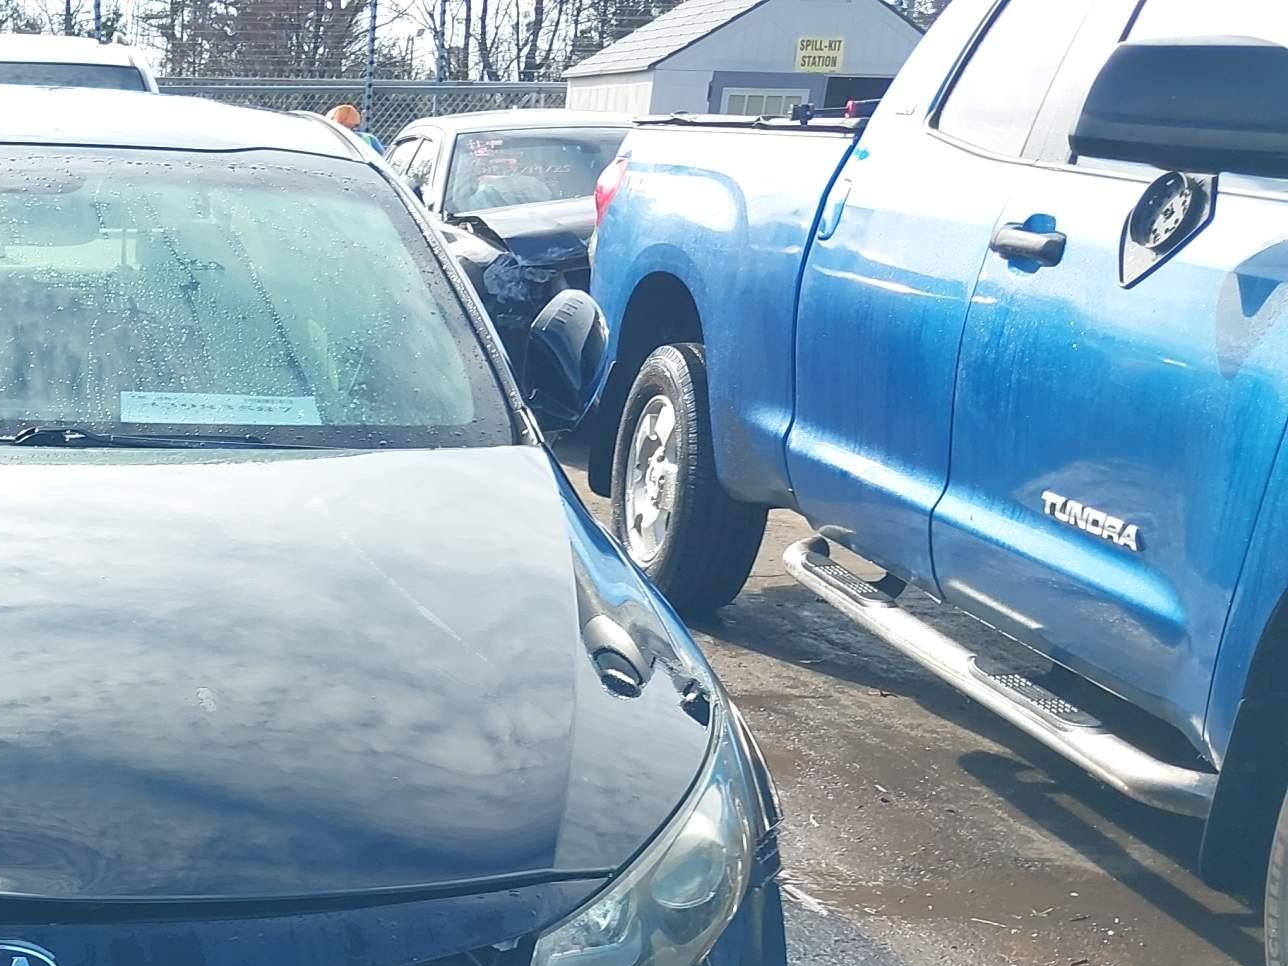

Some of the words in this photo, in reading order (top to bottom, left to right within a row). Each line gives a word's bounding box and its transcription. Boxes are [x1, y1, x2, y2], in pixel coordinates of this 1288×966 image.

[799, 39, 843, 51] SPILL-KIT
[800, 55, 838, 68] STATION
[1040, 489, 1141, 552] TUNDRA
